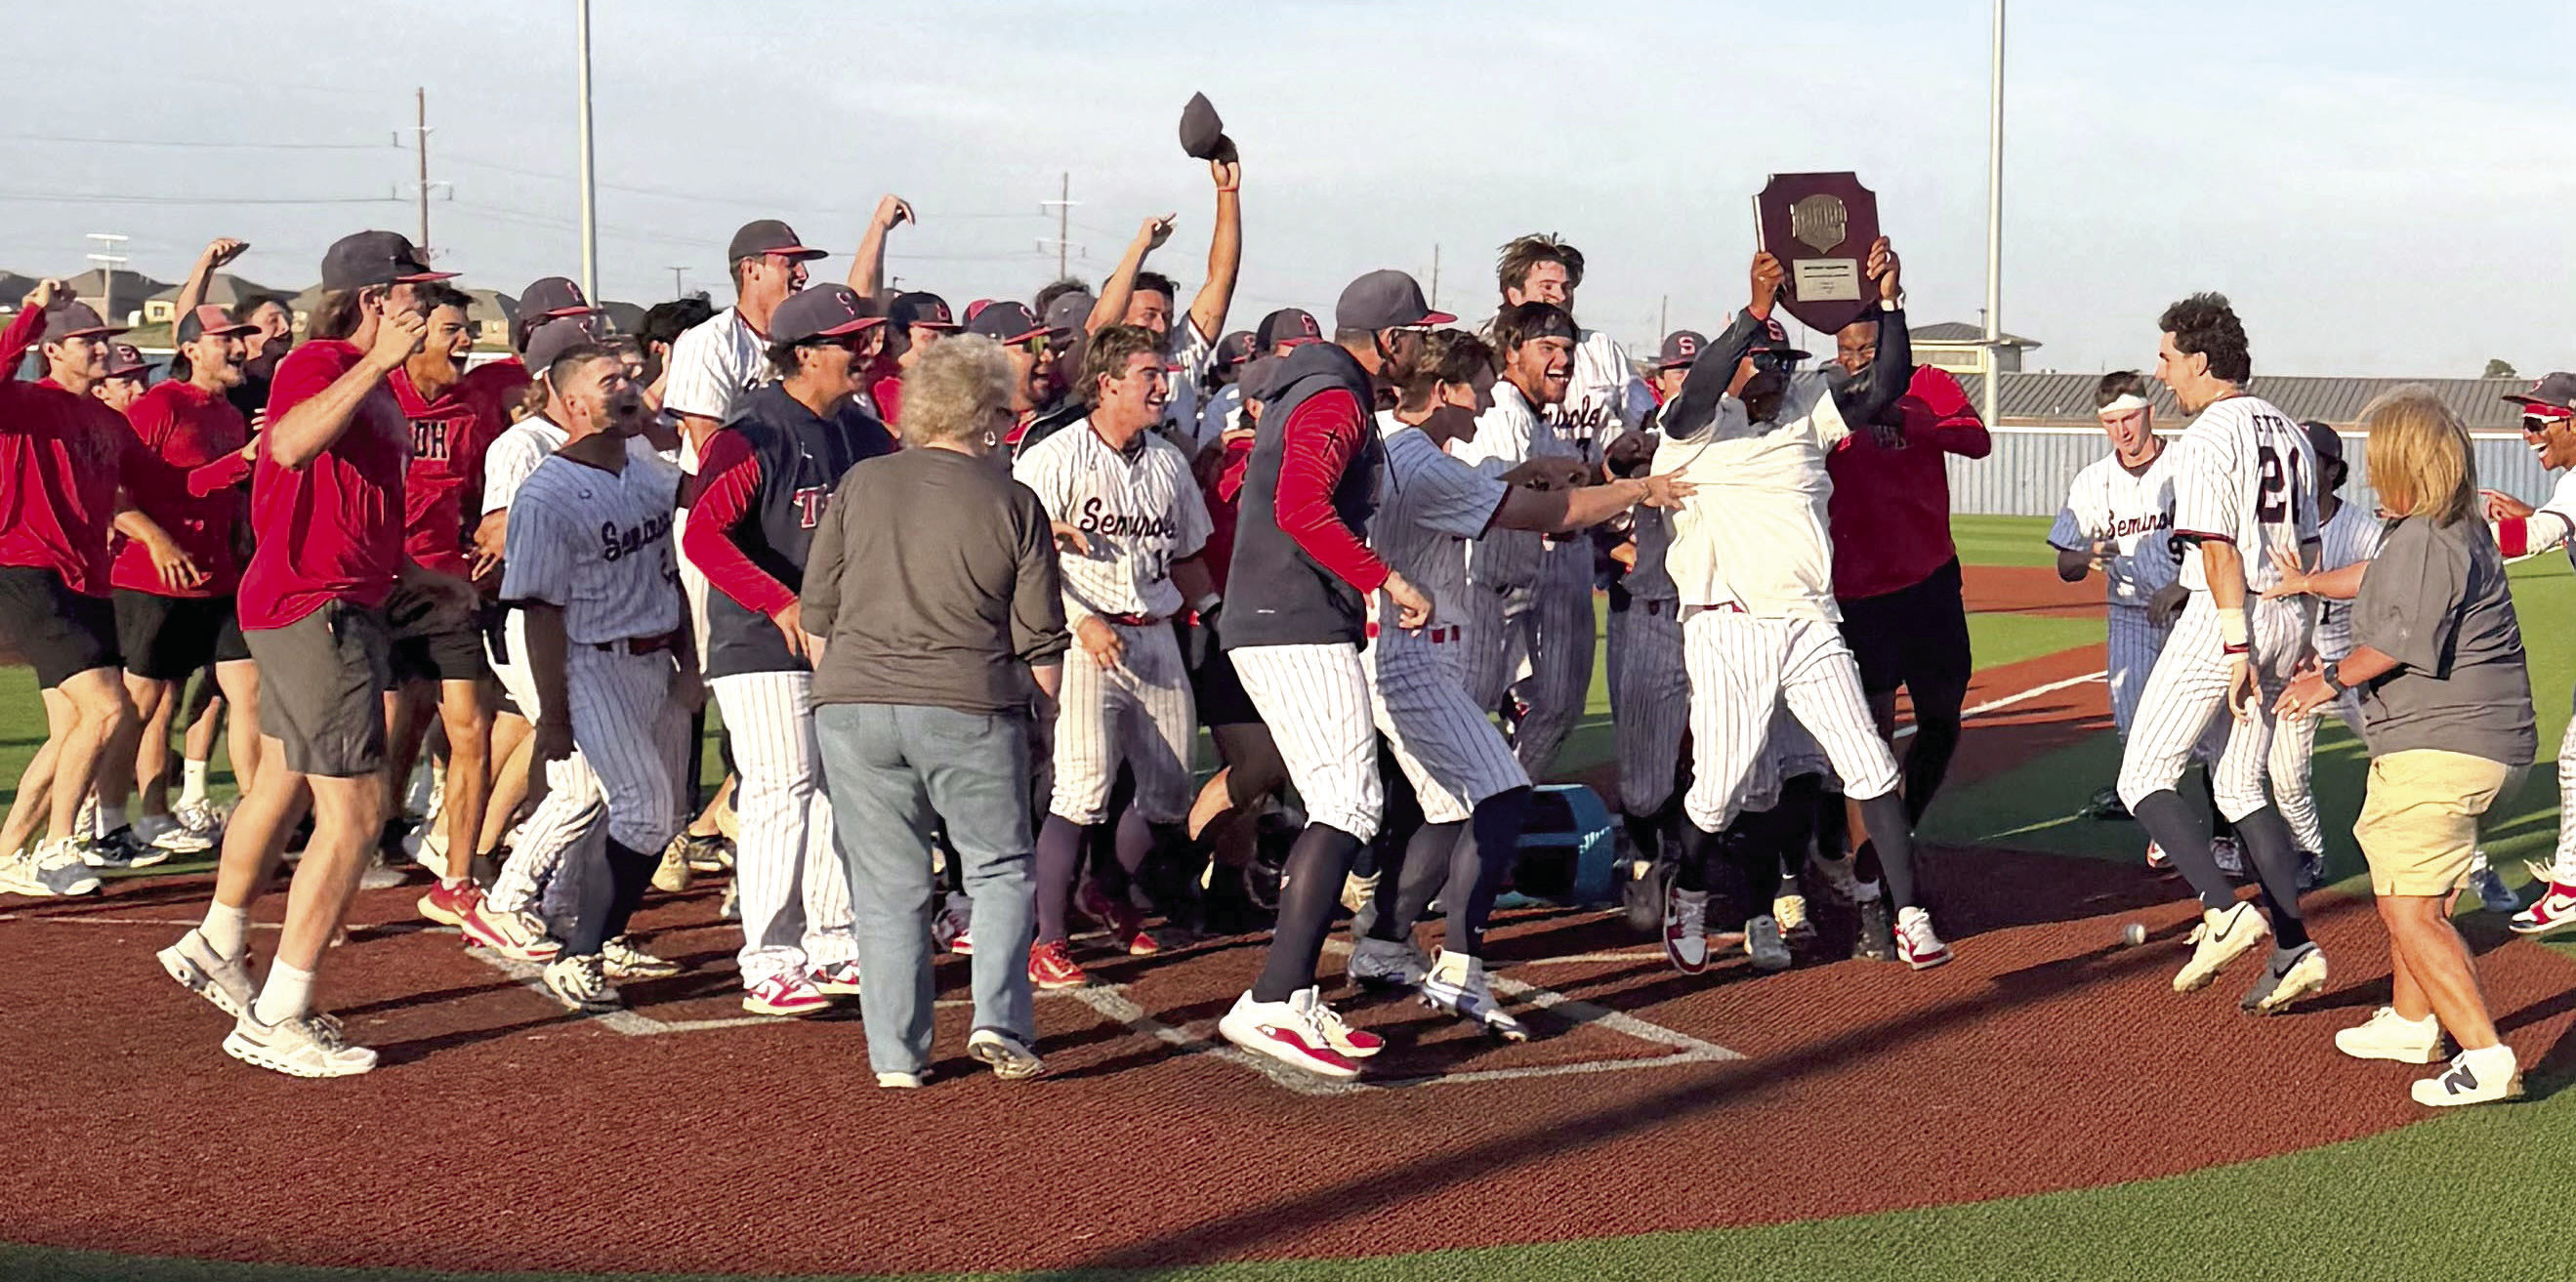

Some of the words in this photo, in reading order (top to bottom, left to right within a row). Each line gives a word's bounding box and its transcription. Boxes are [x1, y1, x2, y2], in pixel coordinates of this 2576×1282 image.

[1766, 317, 1784, 342] S
[1678, 336, 1696, 355] S
[2258, 446, 2300, 524] 21
[2444, 1064, 2478, 1096] N
